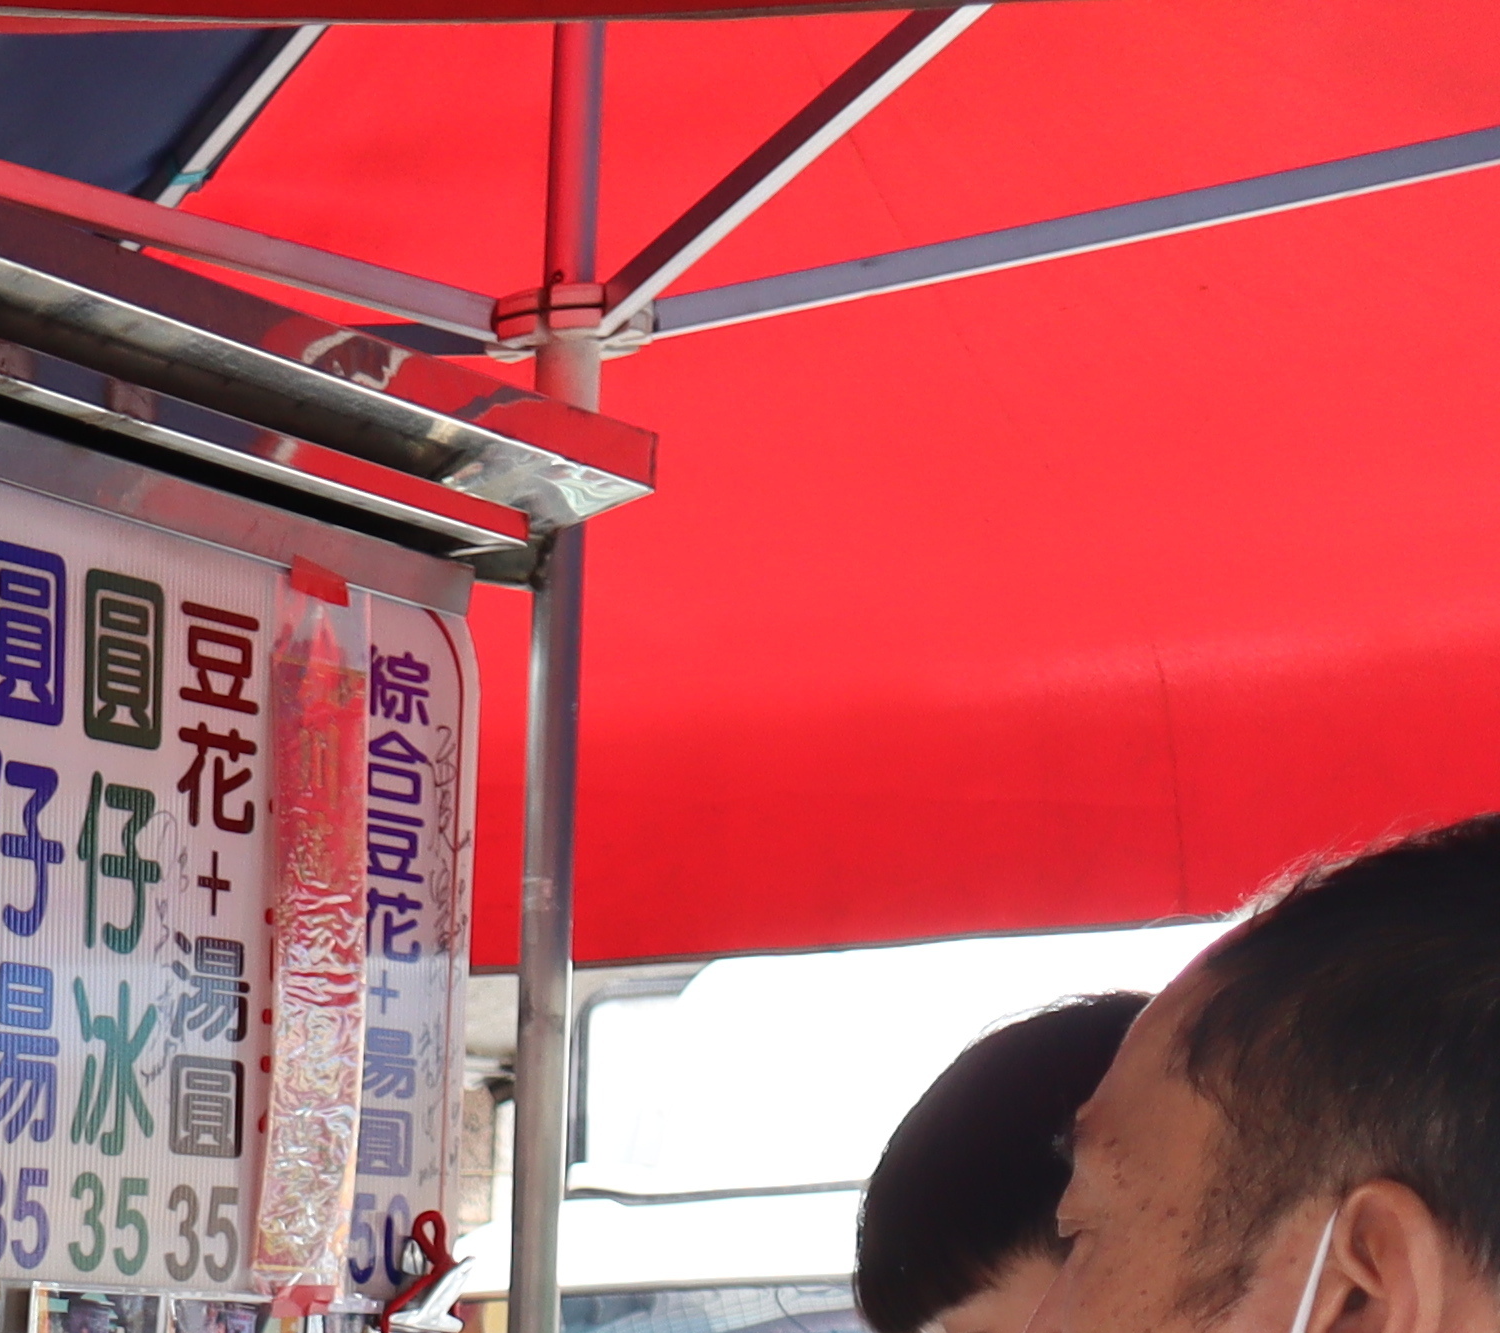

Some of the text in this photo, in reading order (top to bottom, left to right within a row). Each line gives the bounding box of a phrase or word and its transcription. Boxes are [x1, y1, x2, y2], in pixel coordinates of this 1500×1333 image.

[68, 568, 165, 1276] 圓仔冰 35
[163, 601, 260, 1283] 豆花+湯圓 35
